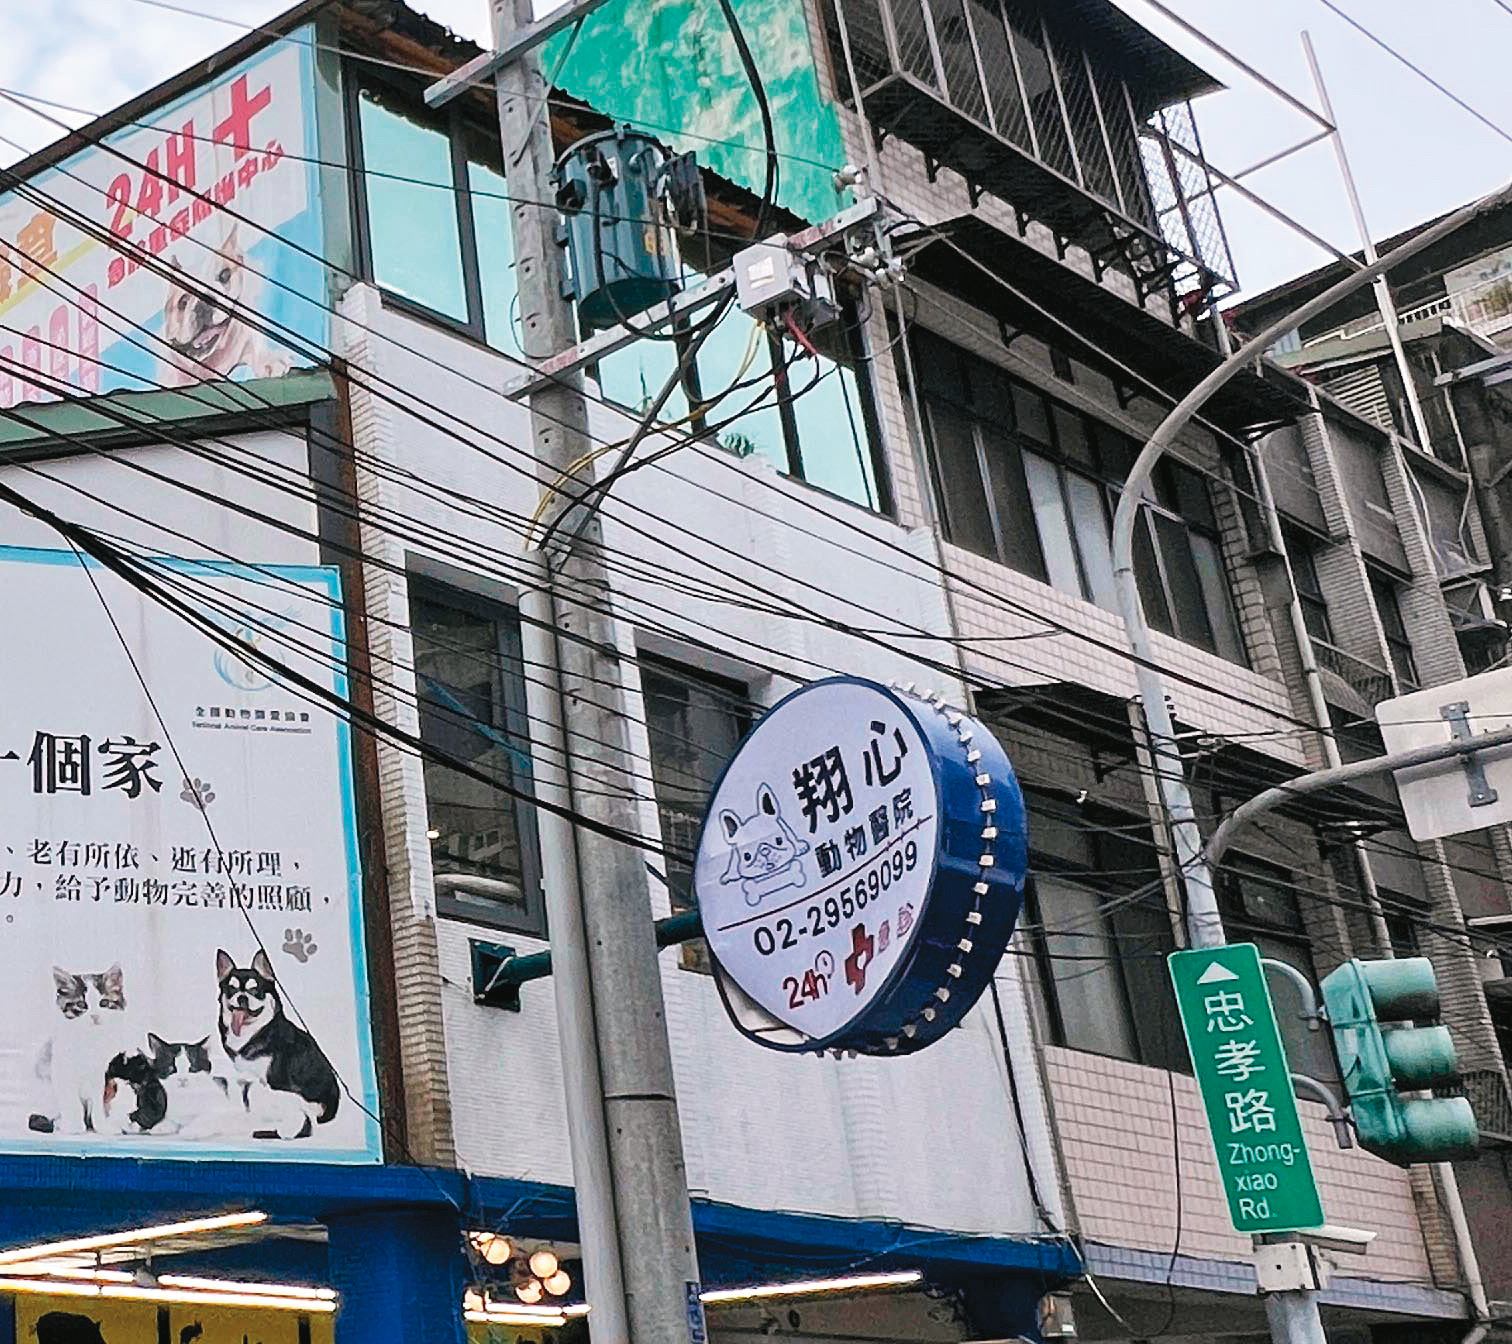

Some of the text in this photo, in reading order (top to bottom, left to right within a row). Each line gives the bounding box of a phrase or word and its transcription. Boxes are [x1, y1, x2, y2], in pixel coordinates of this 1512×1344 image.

[106, 119, 196, 248] 24H
[792, 720, 908, 833] 翔心
[815, 787, 913, 877] 動物醫院
[754, 841, 917, 955] 02-29569099
[1204, 990, 1276, 1134] 忠孝路
[1229, 1143, 1301, 1166] Zhong-
[1235, 1170, 1277, 1191] xiao
